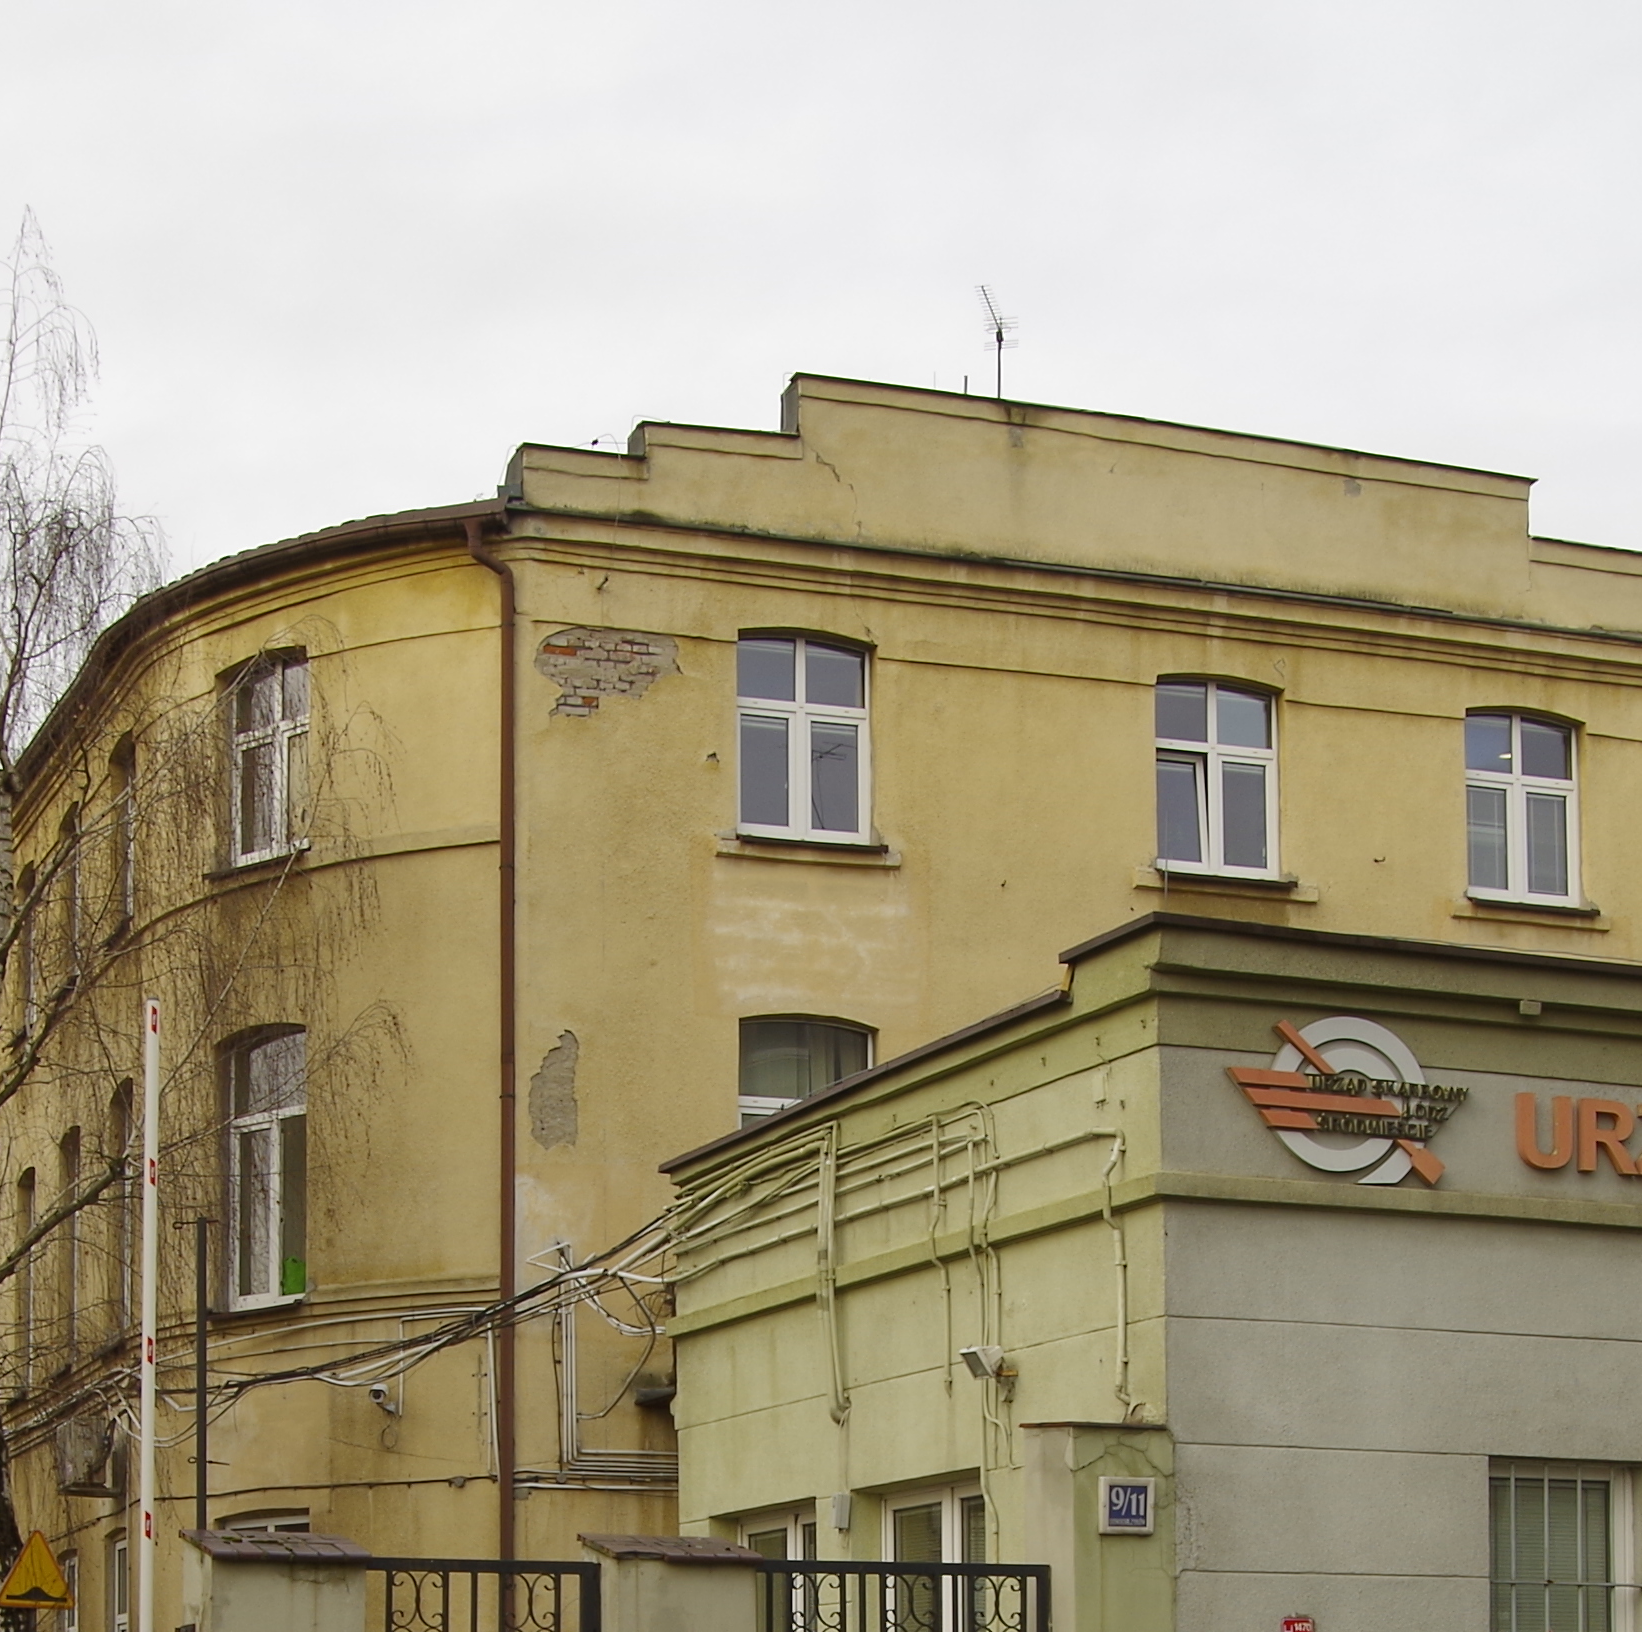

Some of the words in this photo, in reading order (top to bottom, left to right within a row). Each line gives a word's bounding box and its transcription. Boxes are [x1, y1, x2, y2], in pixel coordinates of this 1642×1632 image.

[1308, 1075, 1368, 1097] URZĄD
[1371, 1079, 1470, 1102] SKARBOWY
[1111, 1486, 1146, 1516] 9/11
